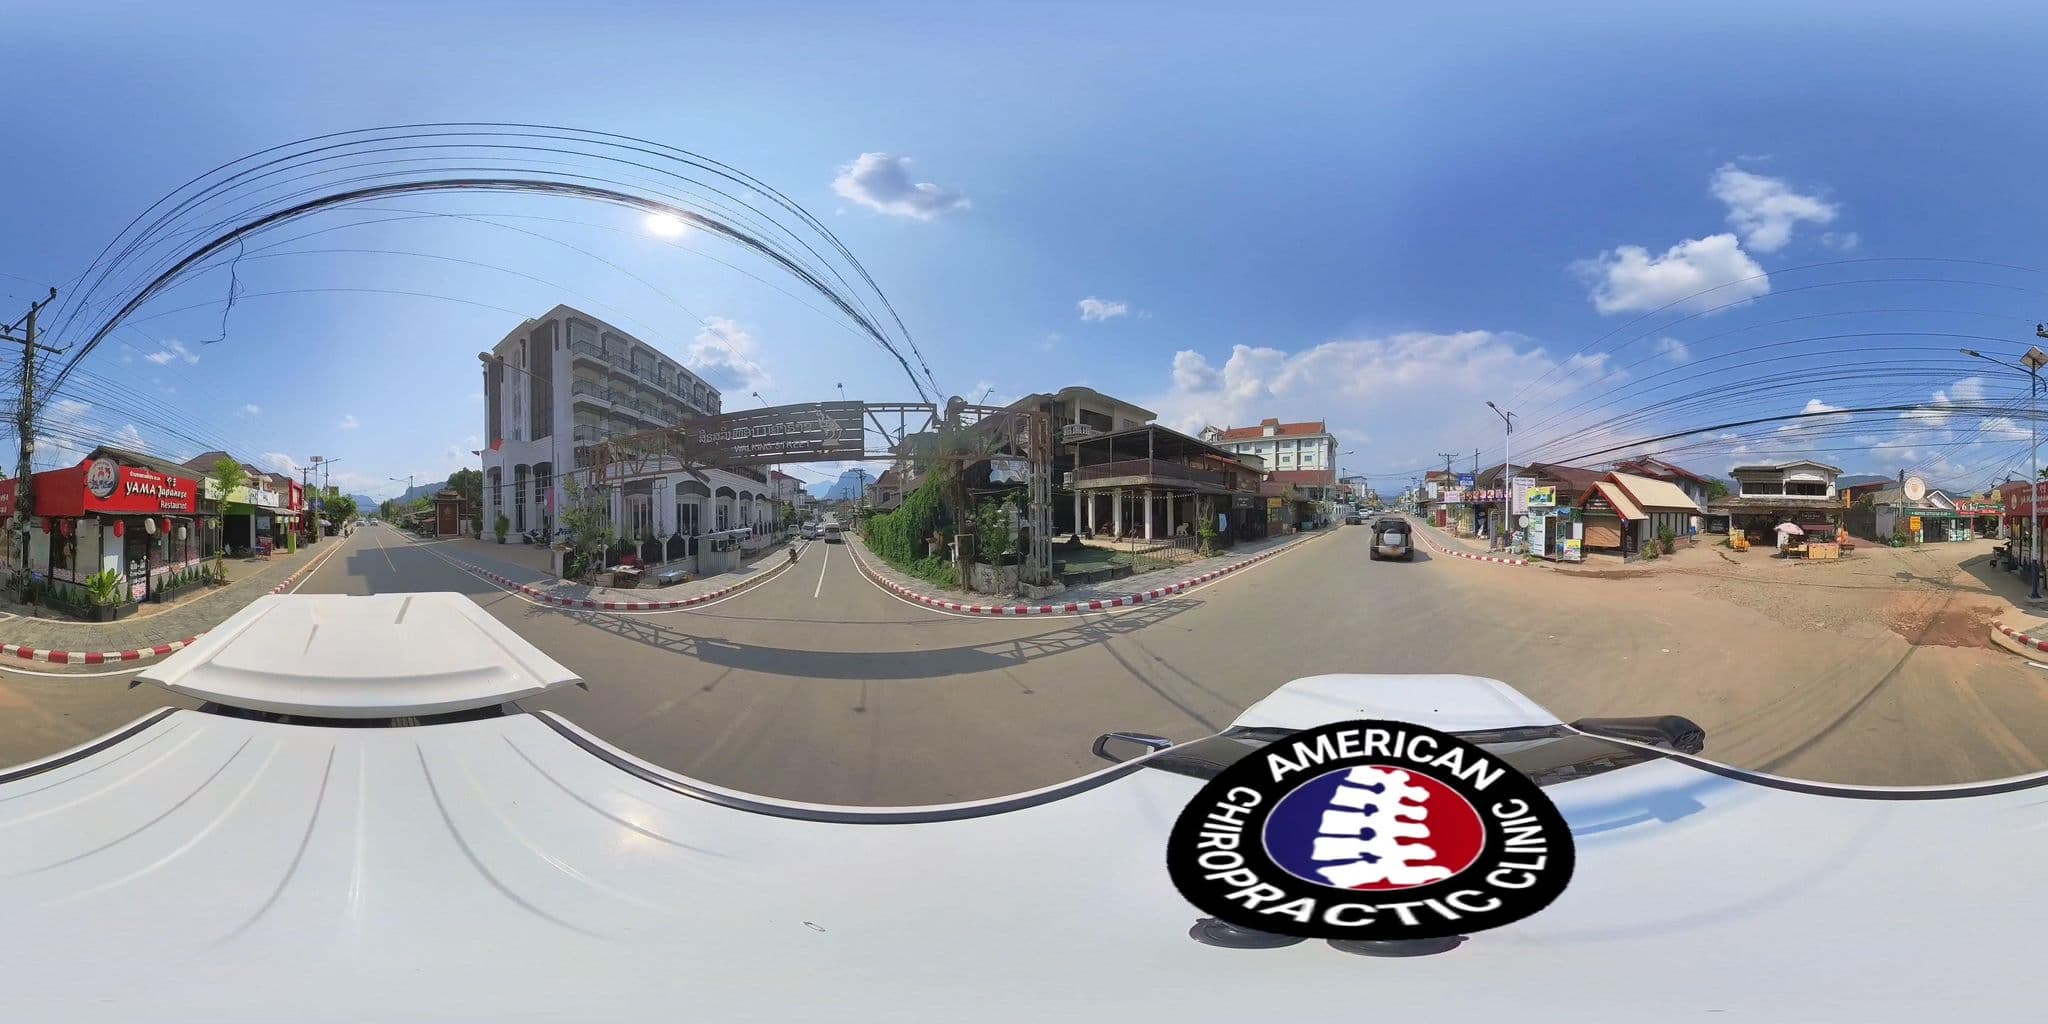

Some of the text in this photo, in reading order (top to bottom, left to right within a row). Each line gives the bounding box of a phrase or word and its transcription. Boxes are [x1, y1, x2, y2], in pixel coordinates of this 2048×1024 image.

[733, 440, 810, 453] WALKING STREET
[126, 481, 156, 496] YAMA
[160, 500, 188, 510] Restaurant
